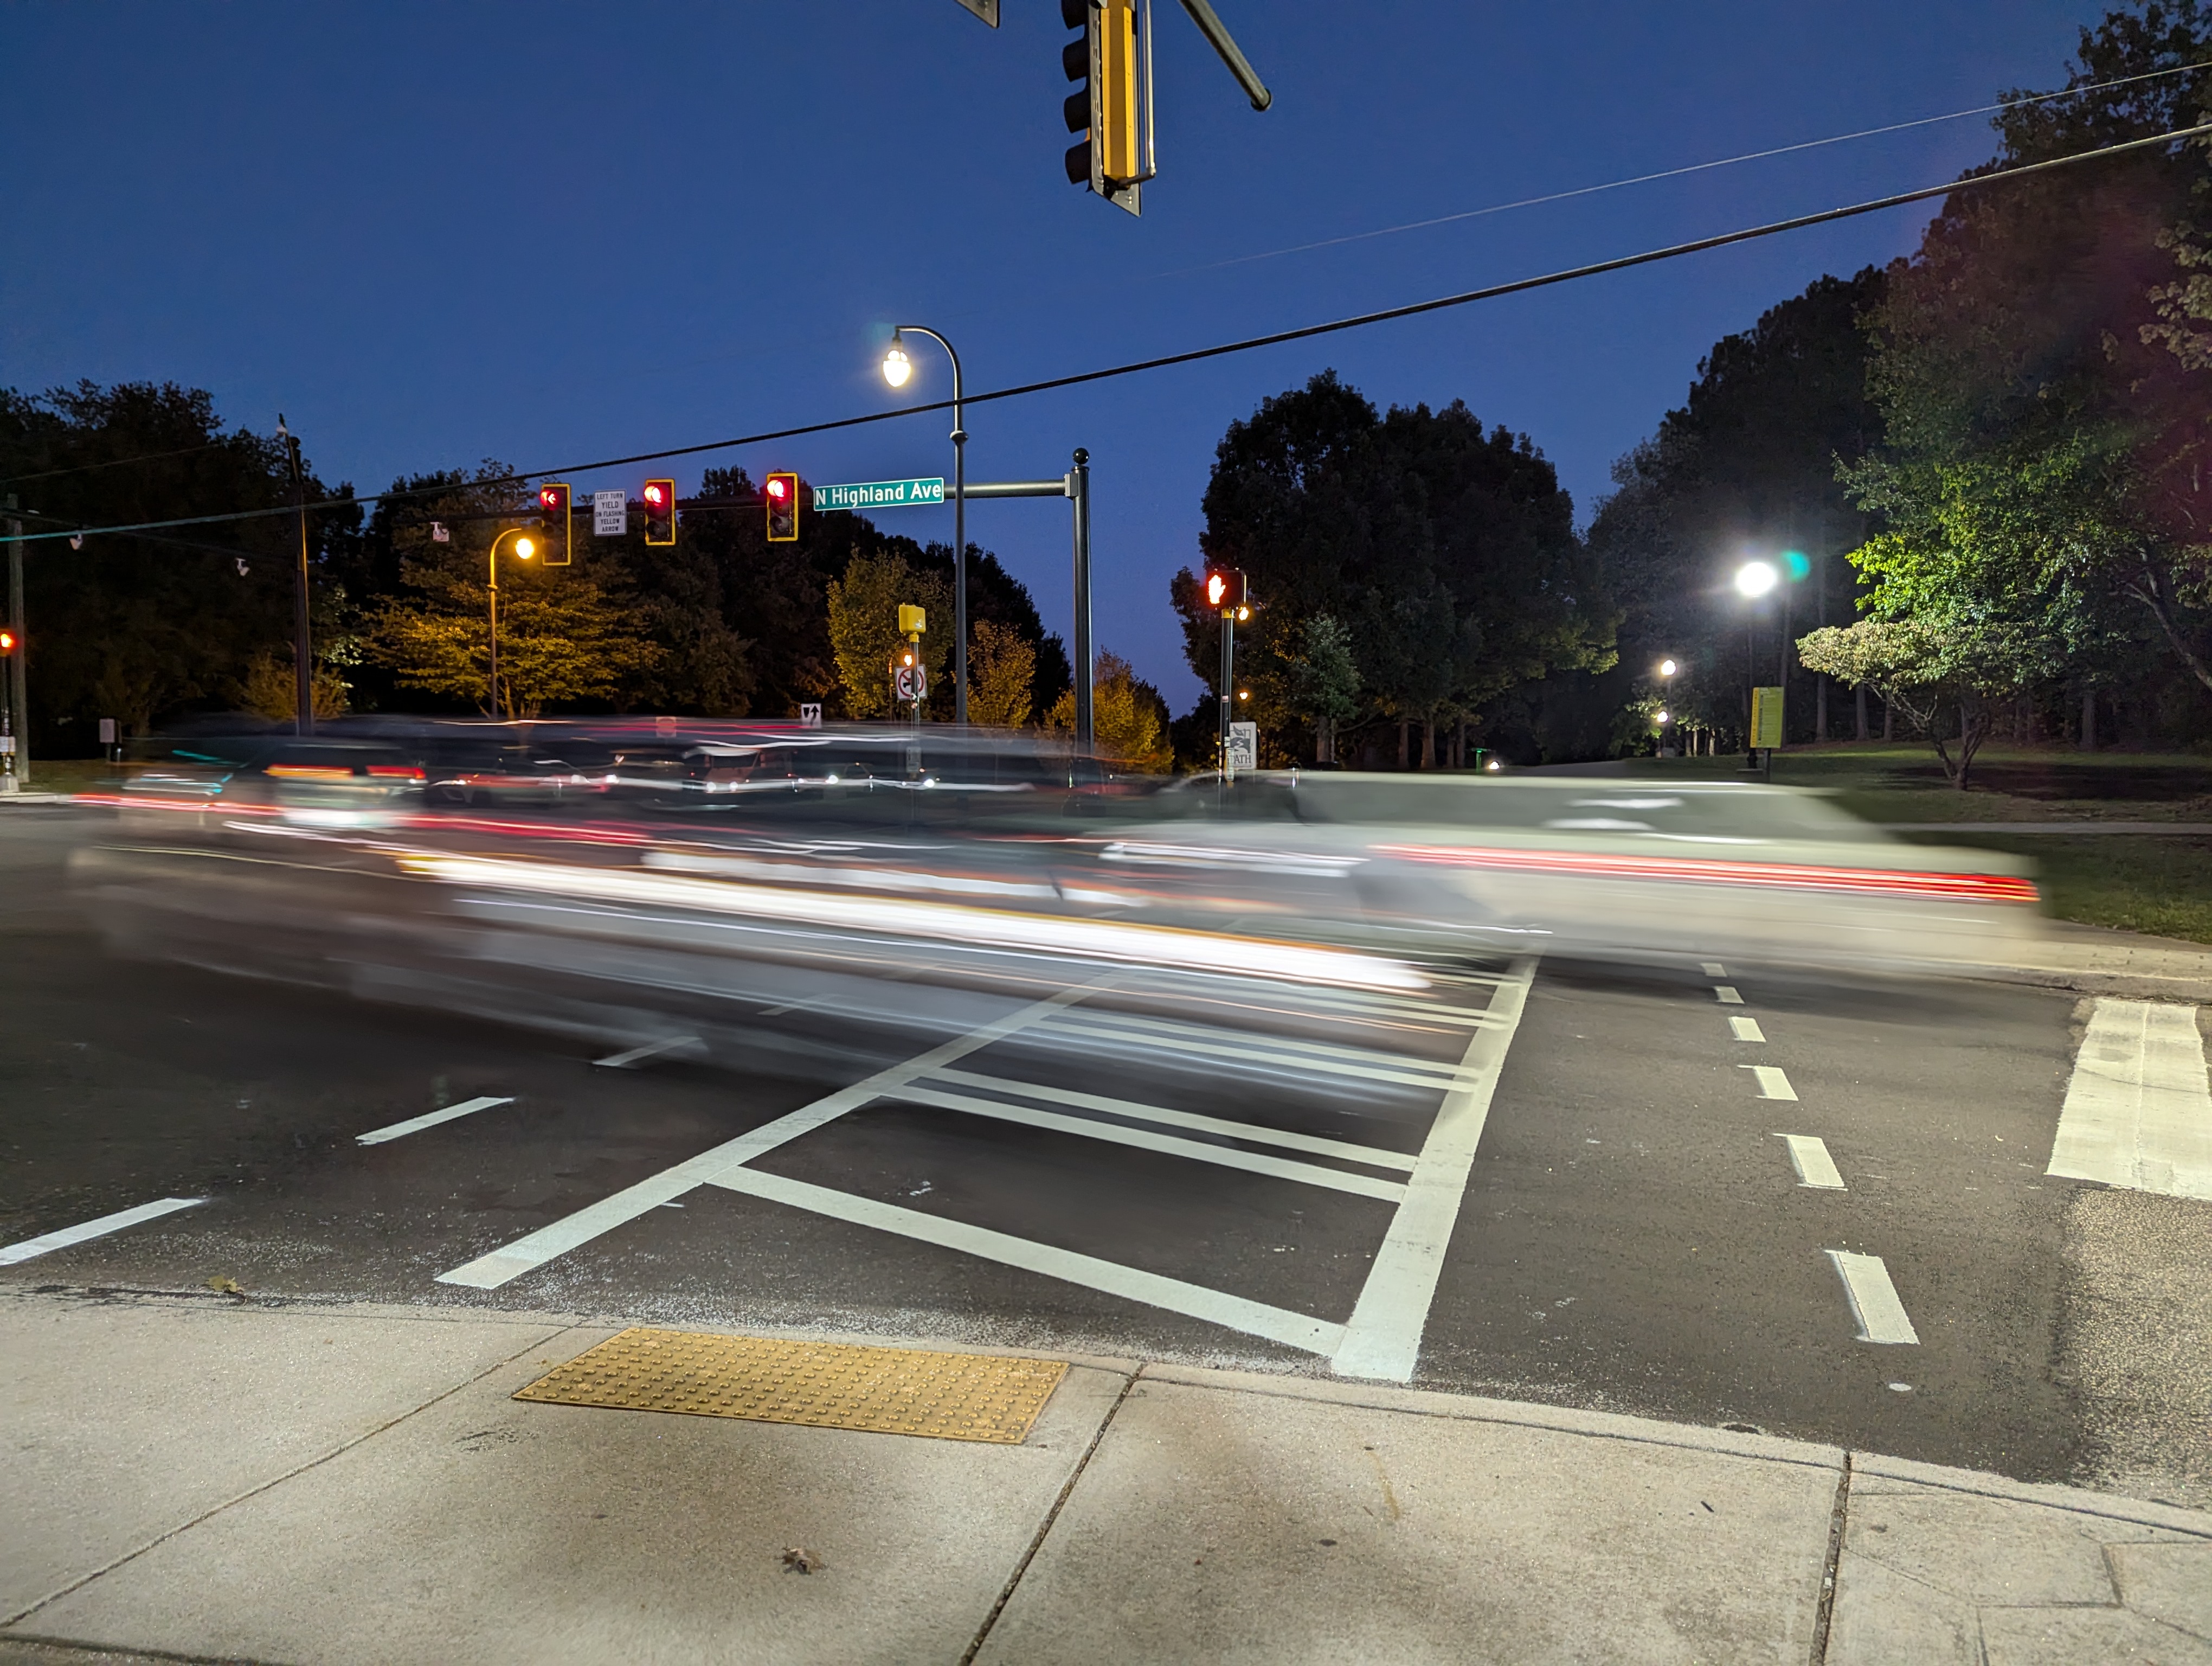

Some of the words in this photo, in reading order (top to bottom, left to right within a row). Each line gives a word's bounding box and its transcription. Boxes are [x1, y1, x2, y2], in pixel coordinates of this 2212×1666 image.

[815, 489, 826, 505] N
[832, 484, 904, 508] Highland
[910, 482, 942, 499] Ave
[1233, 754, 1251, 764] ATH
